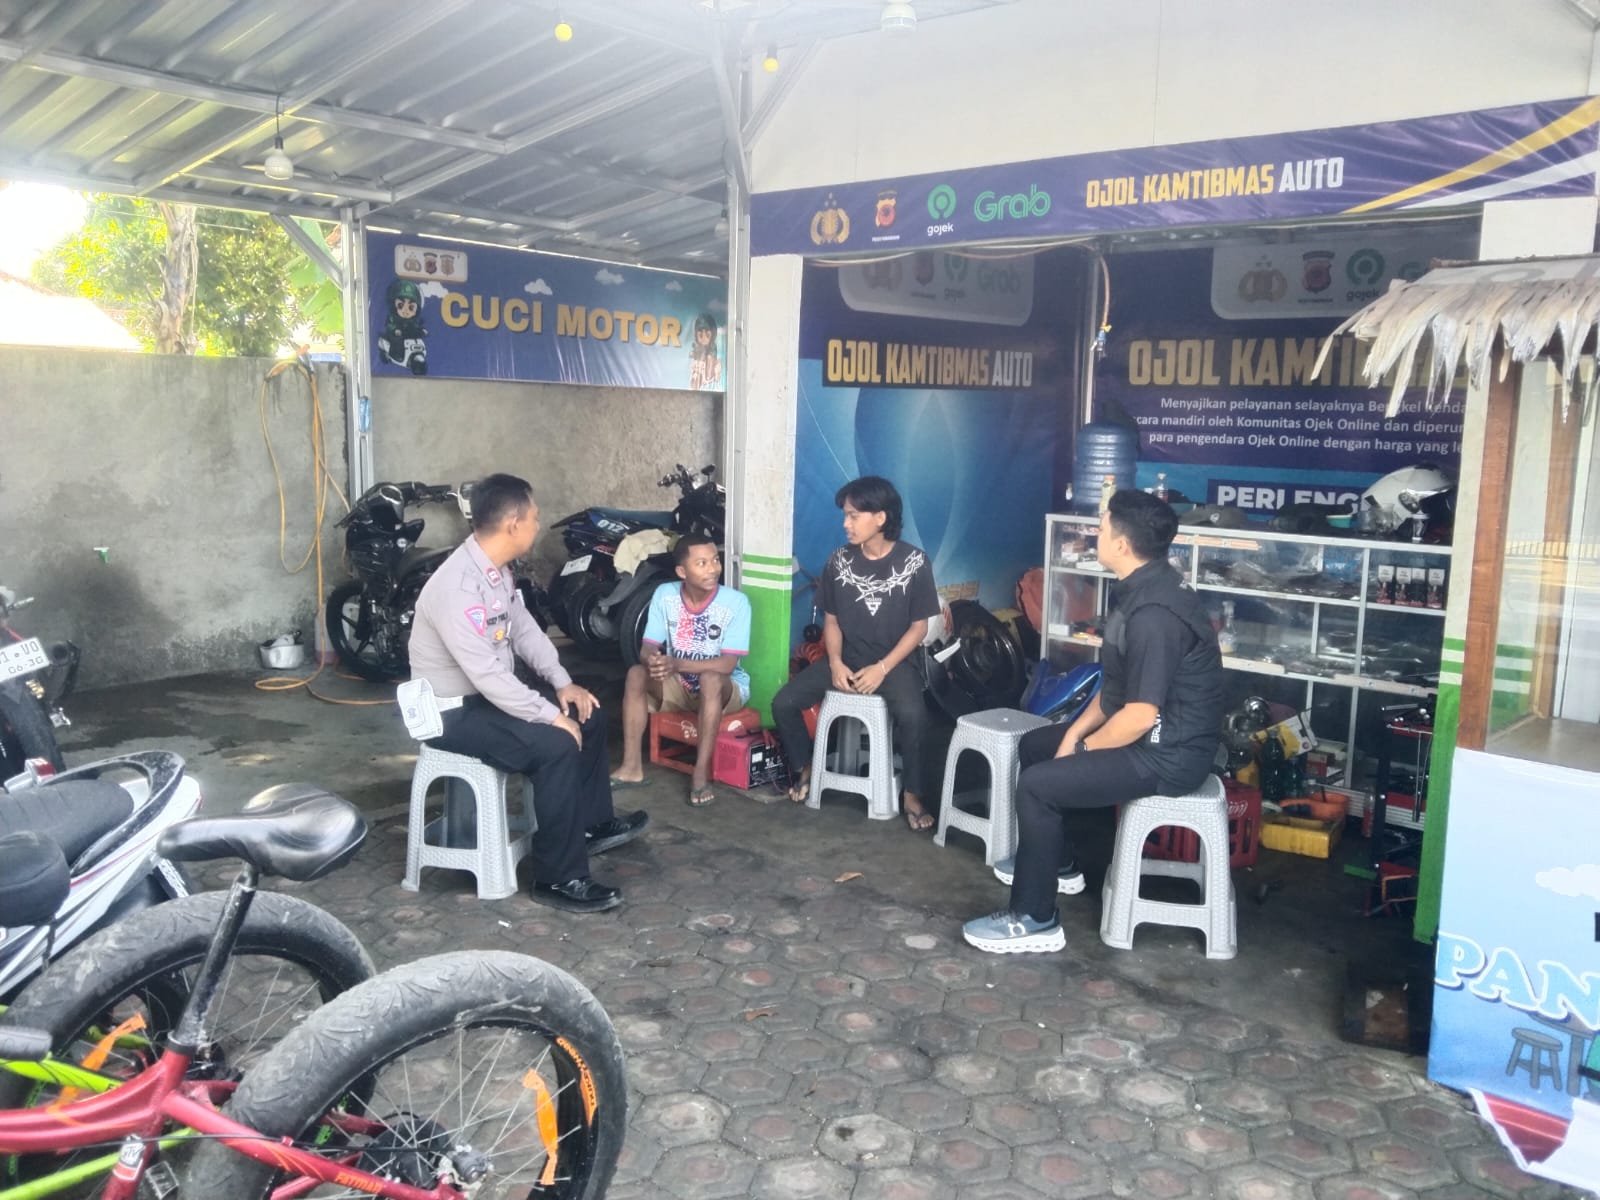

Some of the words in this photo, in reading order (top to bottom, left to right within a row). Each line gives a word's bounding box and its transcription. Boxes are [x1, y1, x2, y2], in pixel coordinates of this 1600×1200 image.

[1085, 178, 1137, 209] OJOL
[1143, 164, 1274, 204] KAMTIBMAS
[1279, 156, 1345, 193] AUTO
[973, 184, 1051, 224] Grab
[926, 222, 955, 238] gojek
[440, 291, 543, 334] CUCI
[556, 303, 682, 348] MOTOR
[827, 339, 881, 383] OJOL
[885, 343, 990, 386] KAMTIBMAS
[991, 350, 1033, 387] AUTO
[1128, 338, 1221, 386] OJOL
[1160, 397, 1227, 411] Menyajikan
[1230, 398, 1292, 413] pelayanan
[1295, 400, 1364, 416] selayaknya
[1368, 402, 1421, 416] Bekel
[1162, 415, 1205, 427] mandiri
[1208, 416, 1233, 428] oleh
[1237, 416, 1301, 430] Komunitas
[1305, 418, 1334, 432] Ojek
[1337, 420, 1380, 432] Online
[1384, 421, 1409, 433] dan
[1149, 433, 1175, 445] para
[1177, 434, 1244, 448] pengendara
[1248, 436, 1276, 449] Ojek
[1279, 437, 1320, 449] Online
[1323, 439, 1371, 452] dengan
[1375, 440, 1412, 454] harga
[1416, 443, 1449, 456] yang
[597, 519, 624, 533] 012
